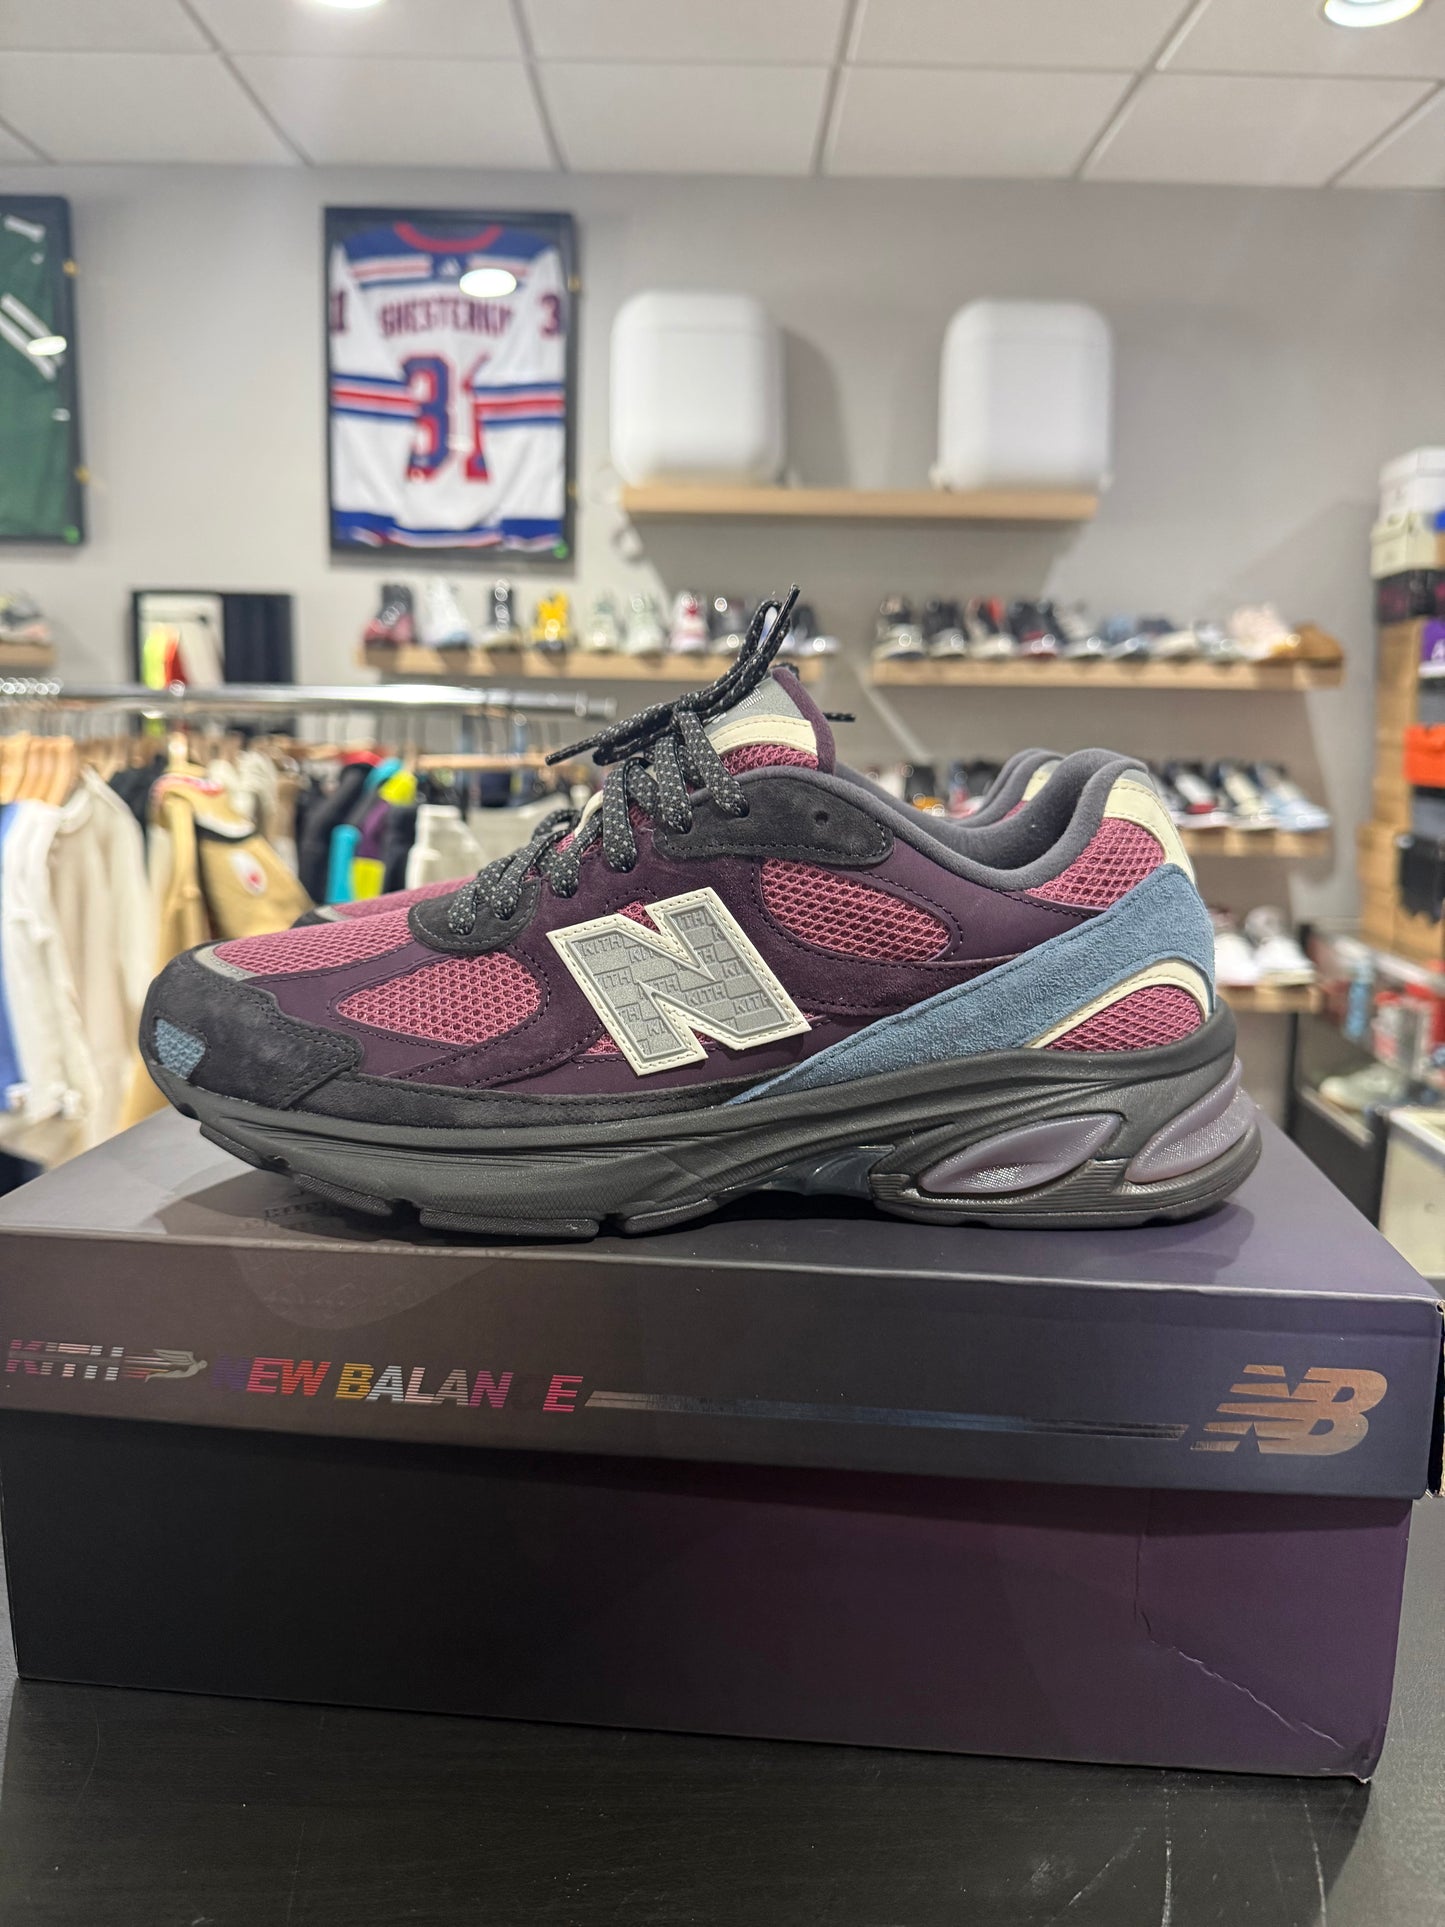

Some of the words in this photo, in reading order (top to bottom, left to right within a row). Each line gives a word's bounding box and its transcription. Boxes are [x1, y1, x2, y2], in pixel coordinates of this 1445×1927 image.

[546, 886, 812, 1077] N
[684, 981, 727, 1007] KITH
[5, 1339, 124, 1381] KITH
[211, 1355, 331, 1395] NEW
[1190, 1364, 1388, 1456] NB
